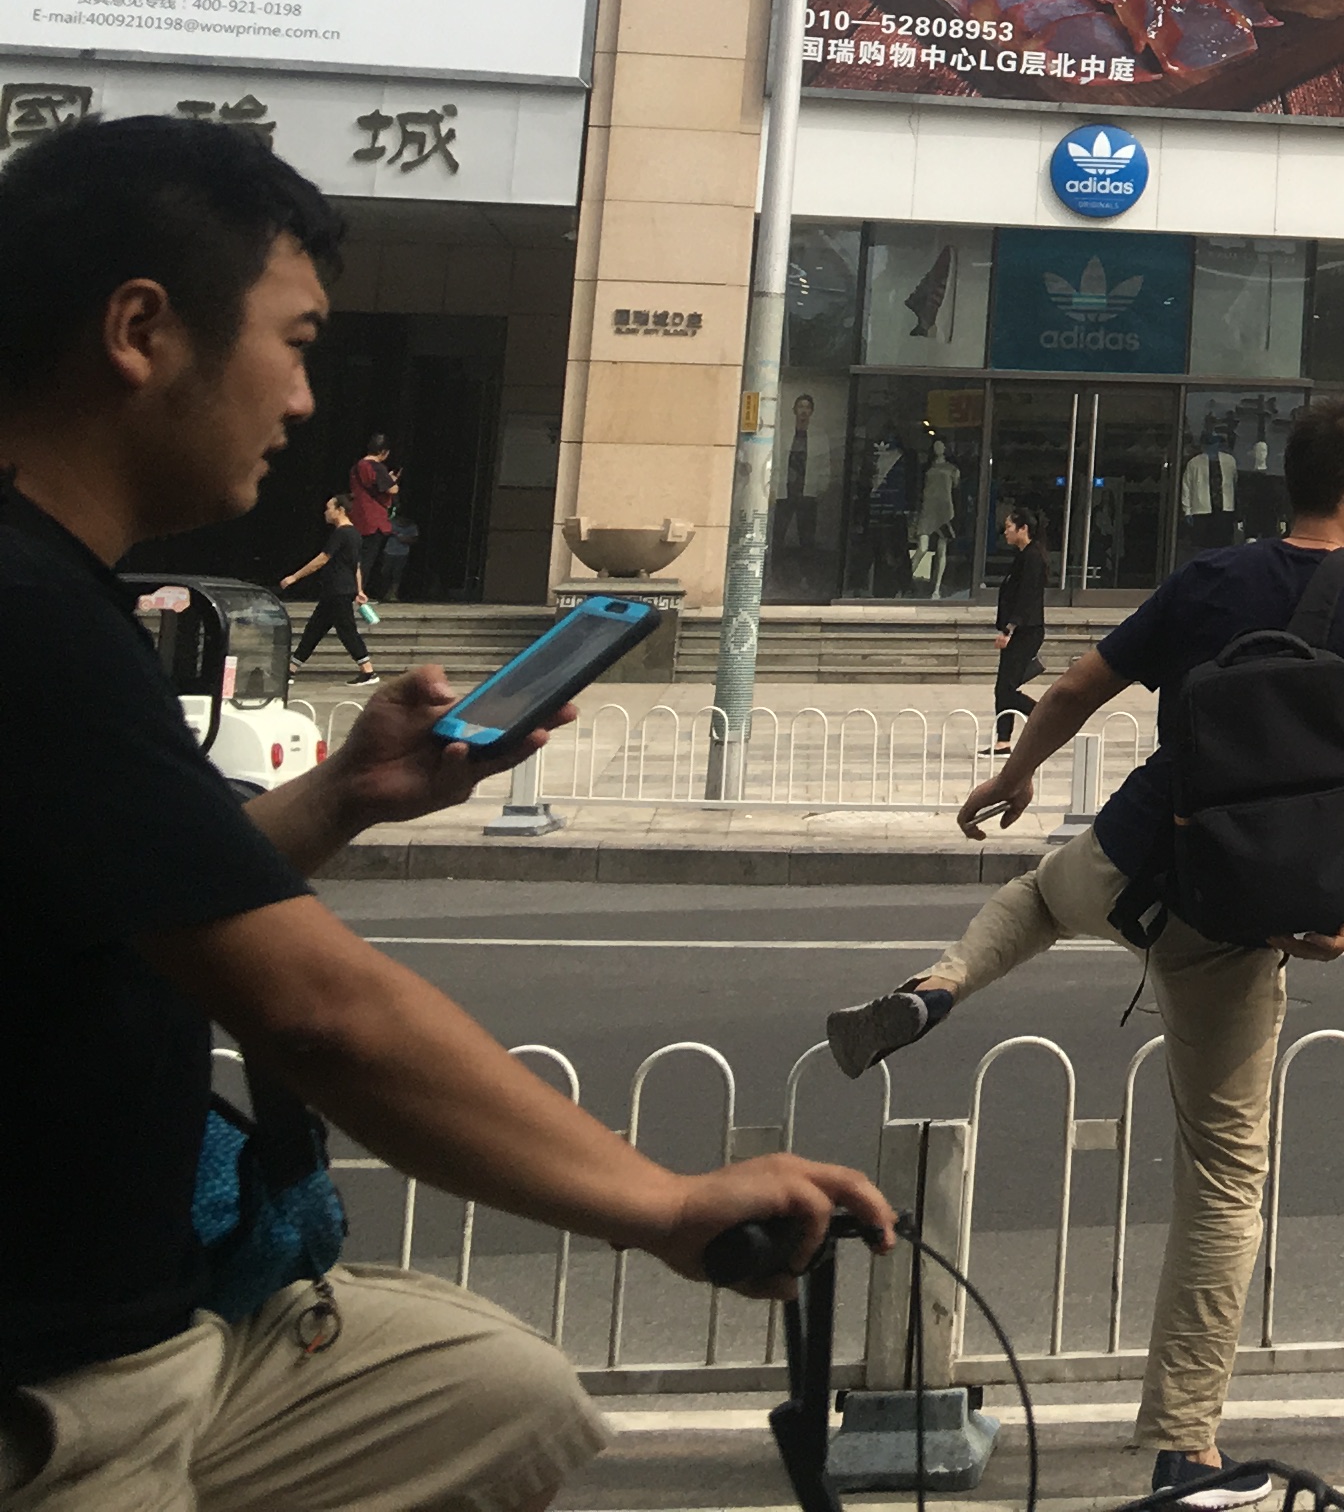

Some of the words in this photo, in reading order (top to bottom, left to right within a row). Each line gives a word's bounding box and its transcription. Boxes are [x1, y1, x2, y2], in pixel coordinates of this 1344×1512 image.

[801, 36, 1136, 84] 国瑞购物中心LG层北中庭
[1065, 177, 1135, 196] adidas
[1039, 325, 1141, 352] adidas
